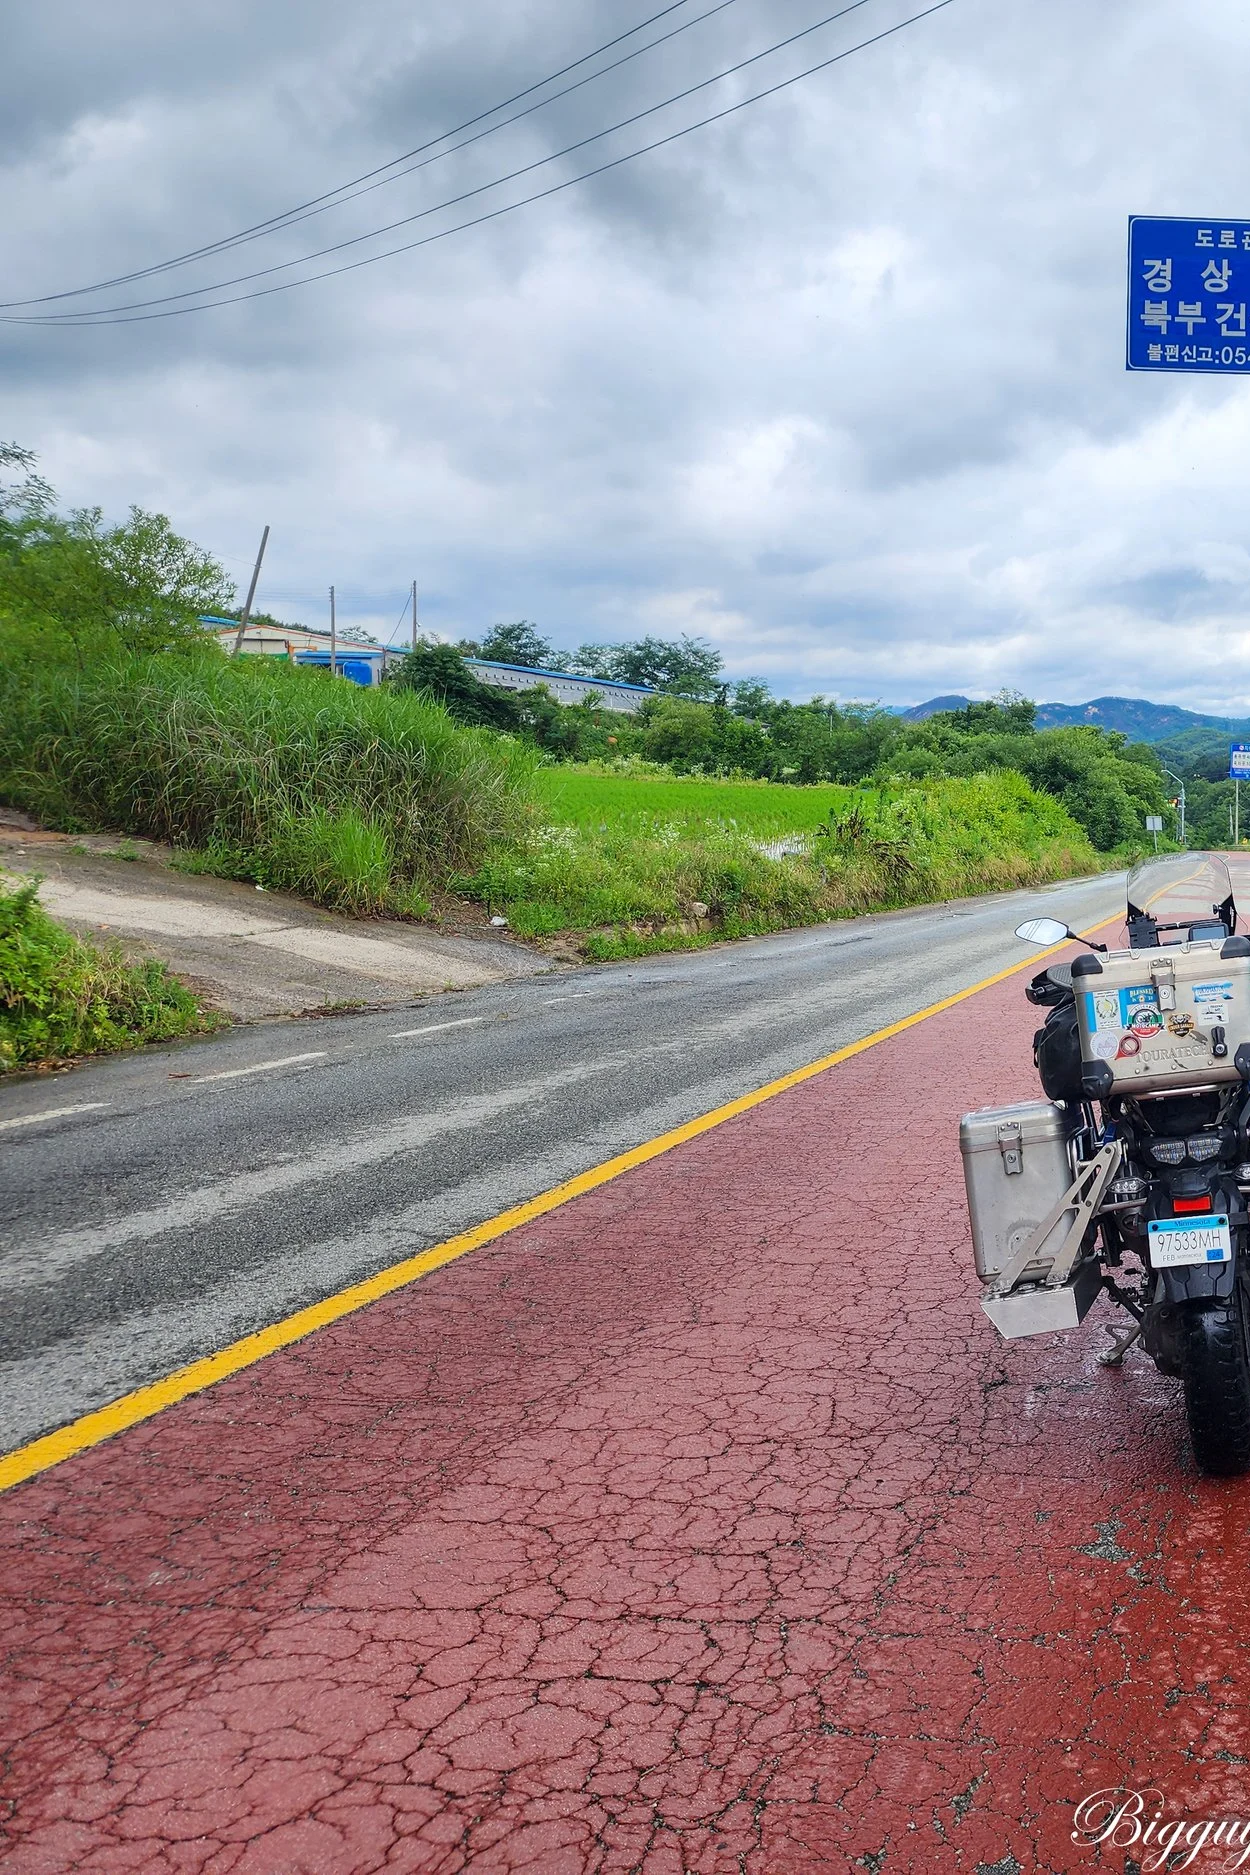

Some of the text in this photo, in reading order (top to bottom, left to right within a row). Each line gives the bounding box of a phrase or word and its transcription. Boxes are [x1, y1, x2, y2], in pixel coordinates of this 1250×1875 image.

[1174, 1219, 1211, 1227] Minnesota
[1157, 1229, 1222, 1253] 97533MH
[1162, 1254, 1176, 1262] FEB
